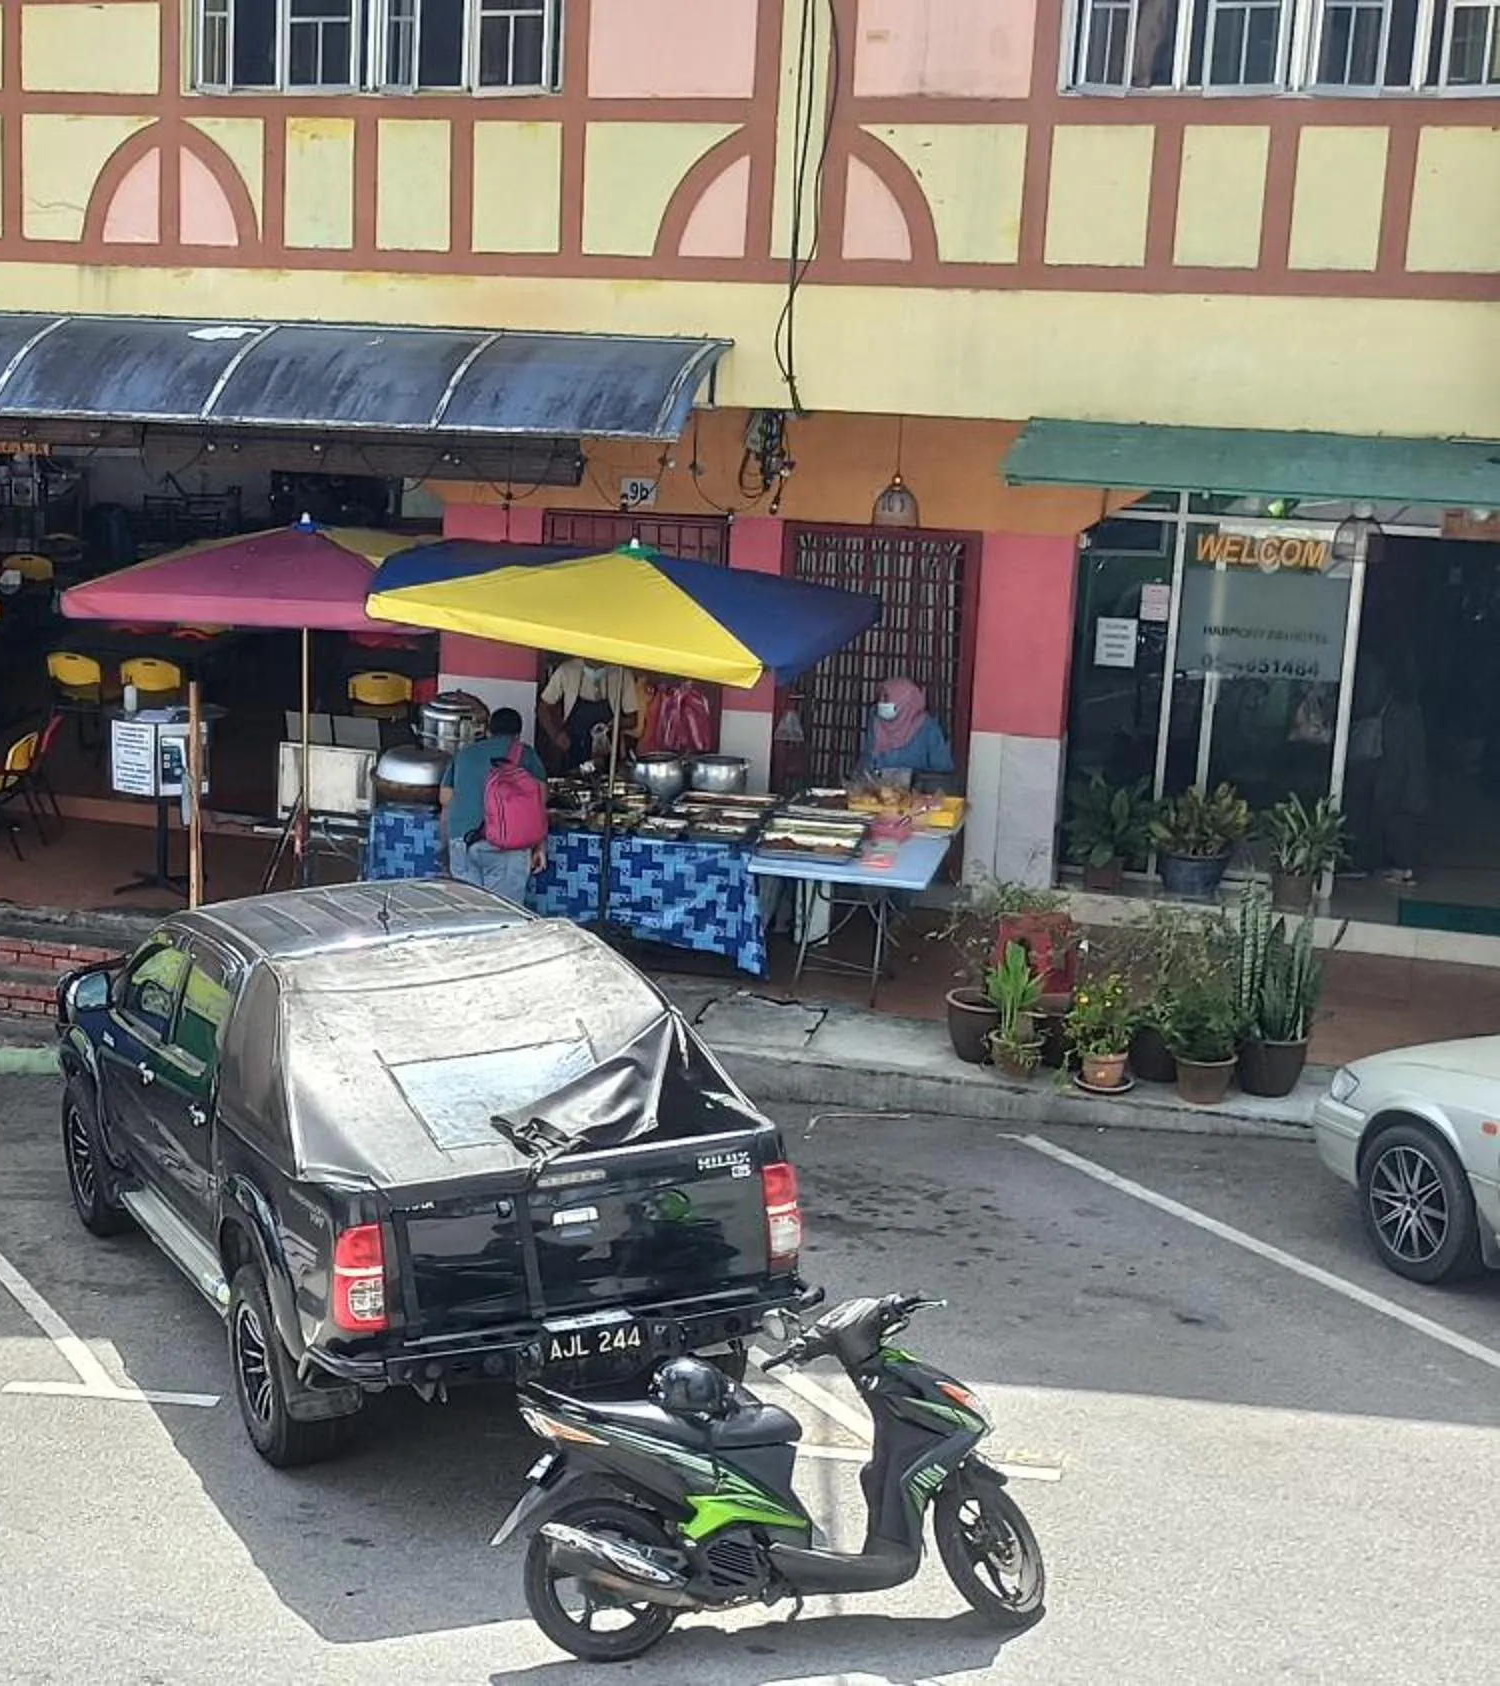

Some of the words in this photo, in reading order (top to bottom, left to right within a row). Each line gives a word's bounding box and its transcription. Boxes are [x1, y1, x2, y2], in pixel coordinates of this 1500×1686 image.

[629, 481, 650, 501] 9b
[549, 1333, 589, 1361] AJL
[599, 1325, 642, 1352] 244
